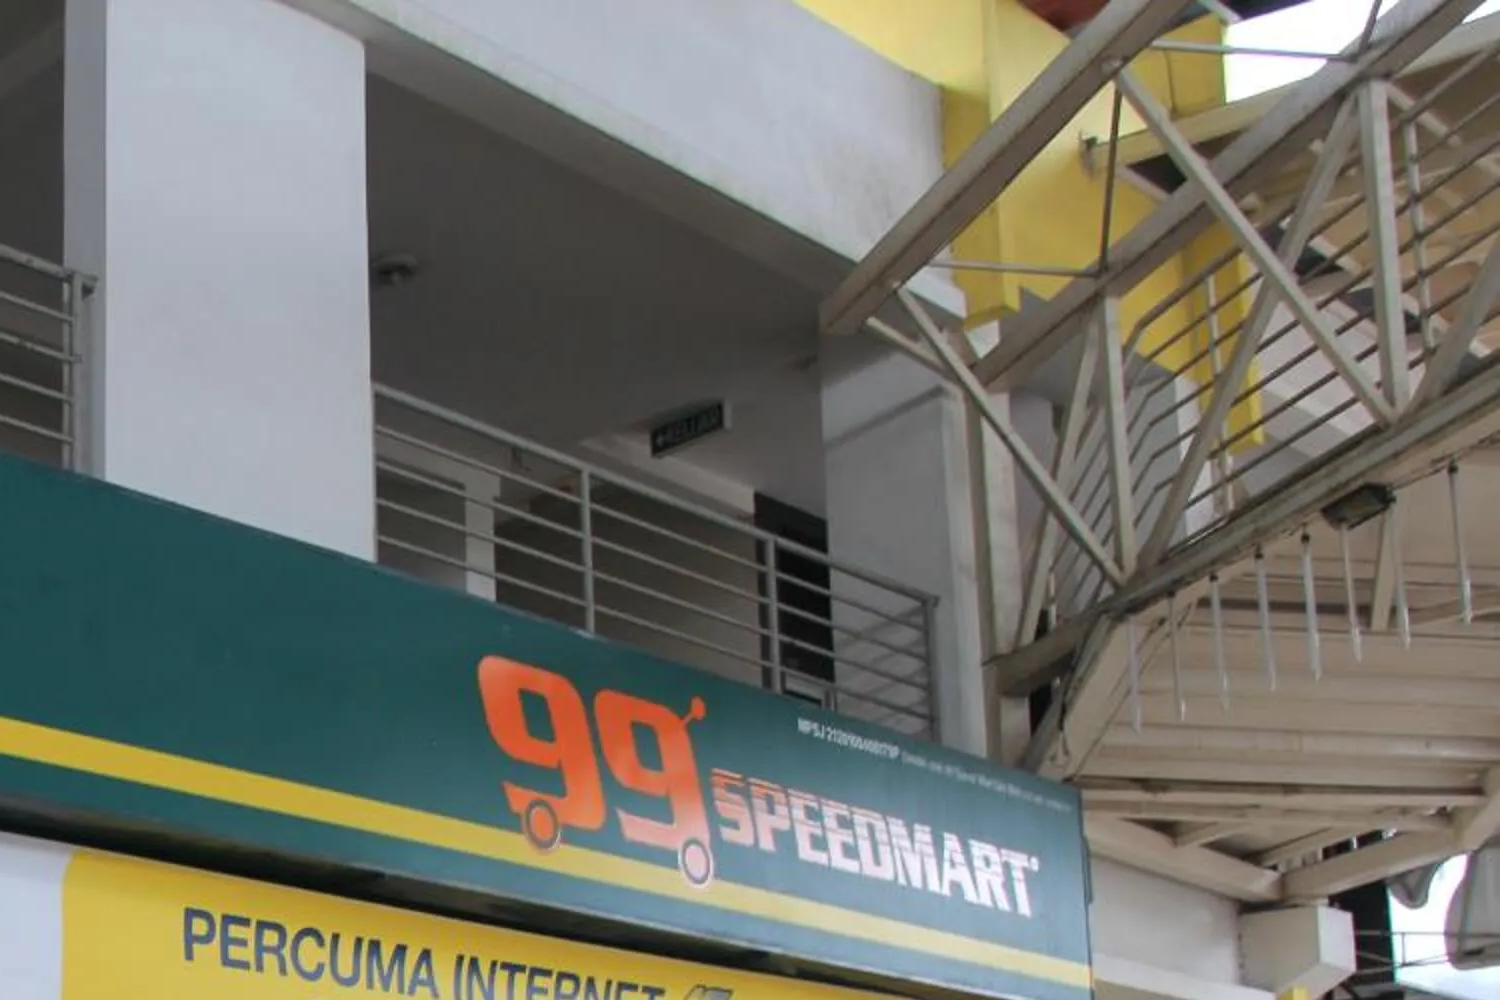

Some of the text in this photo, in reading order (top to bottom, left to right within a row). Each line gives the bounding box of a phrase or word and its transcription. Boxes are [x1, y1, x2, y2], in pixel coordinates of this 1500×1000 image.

[477, 655, 715, 889] 99
[710, 767, 1038, 919] SPEEDMART
[183, 907, 440, 1000] PERCUMA
